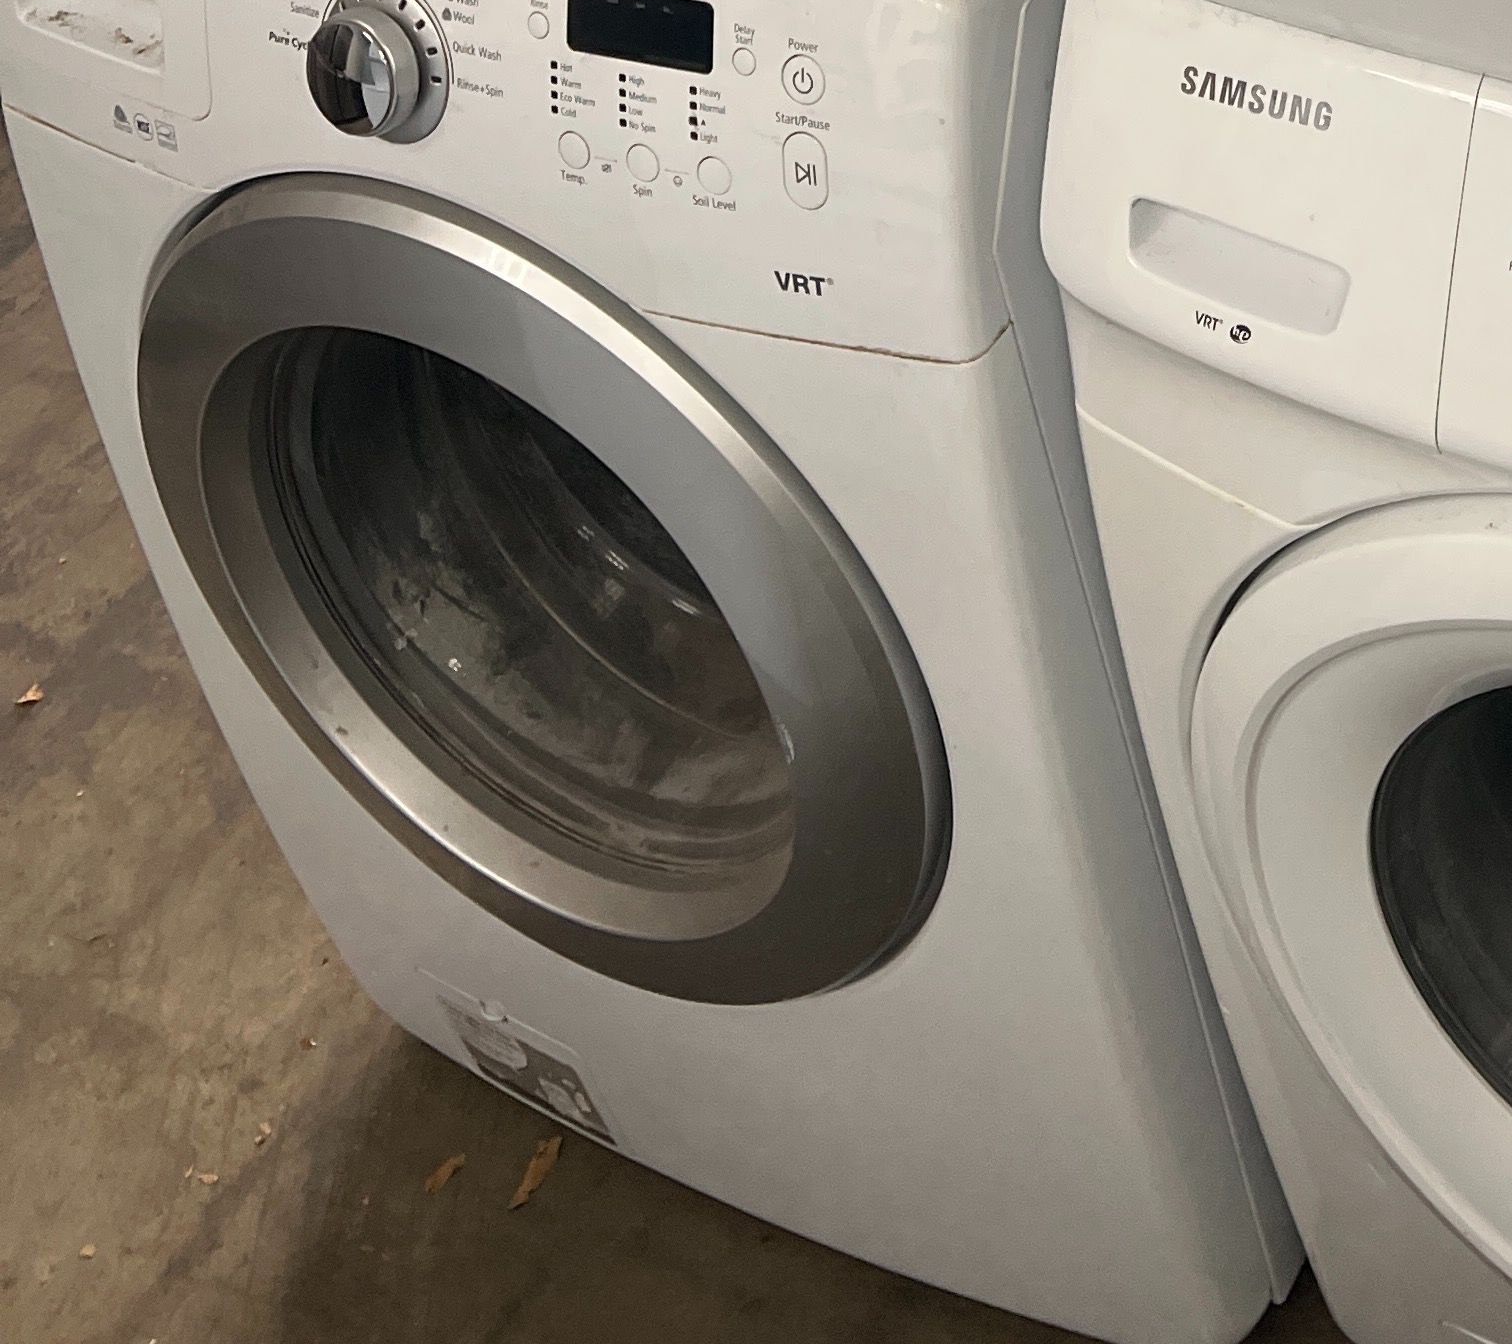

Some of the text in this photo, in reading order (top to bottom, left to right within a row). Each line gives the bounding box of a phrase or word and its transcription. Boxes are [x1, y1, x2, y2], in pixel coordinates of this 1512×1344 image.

[453, 11, 475, 25] Wool
[453, 40, 501, 62] Quick Wash
[788, 37, 819, 53] Power
[1180, 65, 1333, 131] SAMSUNG
[775, 112, 831, 131] Start/Pause
[632, 184, 653, 197] Spin
[692, 195, 736, 211] Soil Level
